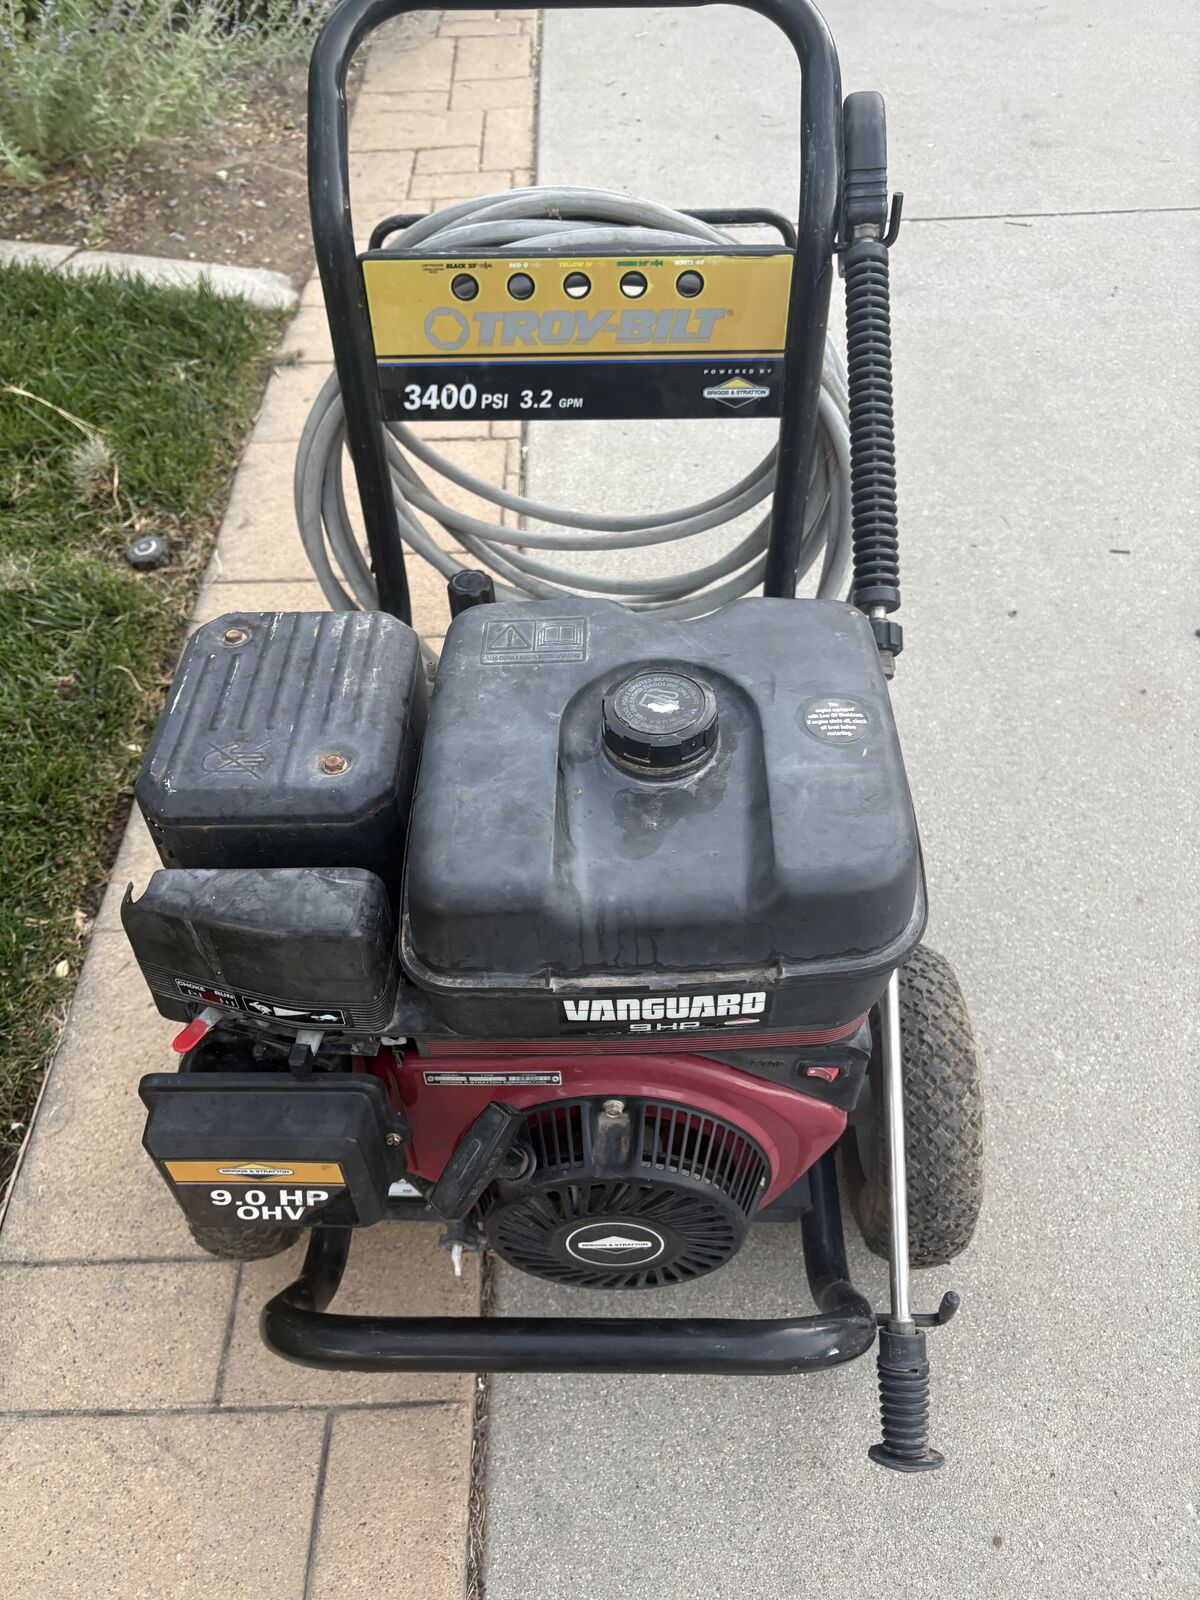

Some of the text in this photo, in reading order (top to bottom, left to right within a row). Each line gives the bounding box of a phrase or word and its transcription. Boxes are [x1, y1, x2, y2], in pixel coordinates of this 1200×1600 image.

[473, 308, 725, 347] TROY-BILT
[403, 383, 584, 411] 3400 PSI 3.2 GPM
[628, 678, 654, 692] MINUTES
[643, 682, 678, 690] GASOLINE
[177, 980, 234, 1000] CHOKE RUN
[562, 991, 767, 1021] VANGUARD
[630, 1021, 701, 1032] 9 HP
[210, 1190, 329, 1206] 9.0 HP
[236, 1206, 306, 1220] OHV
